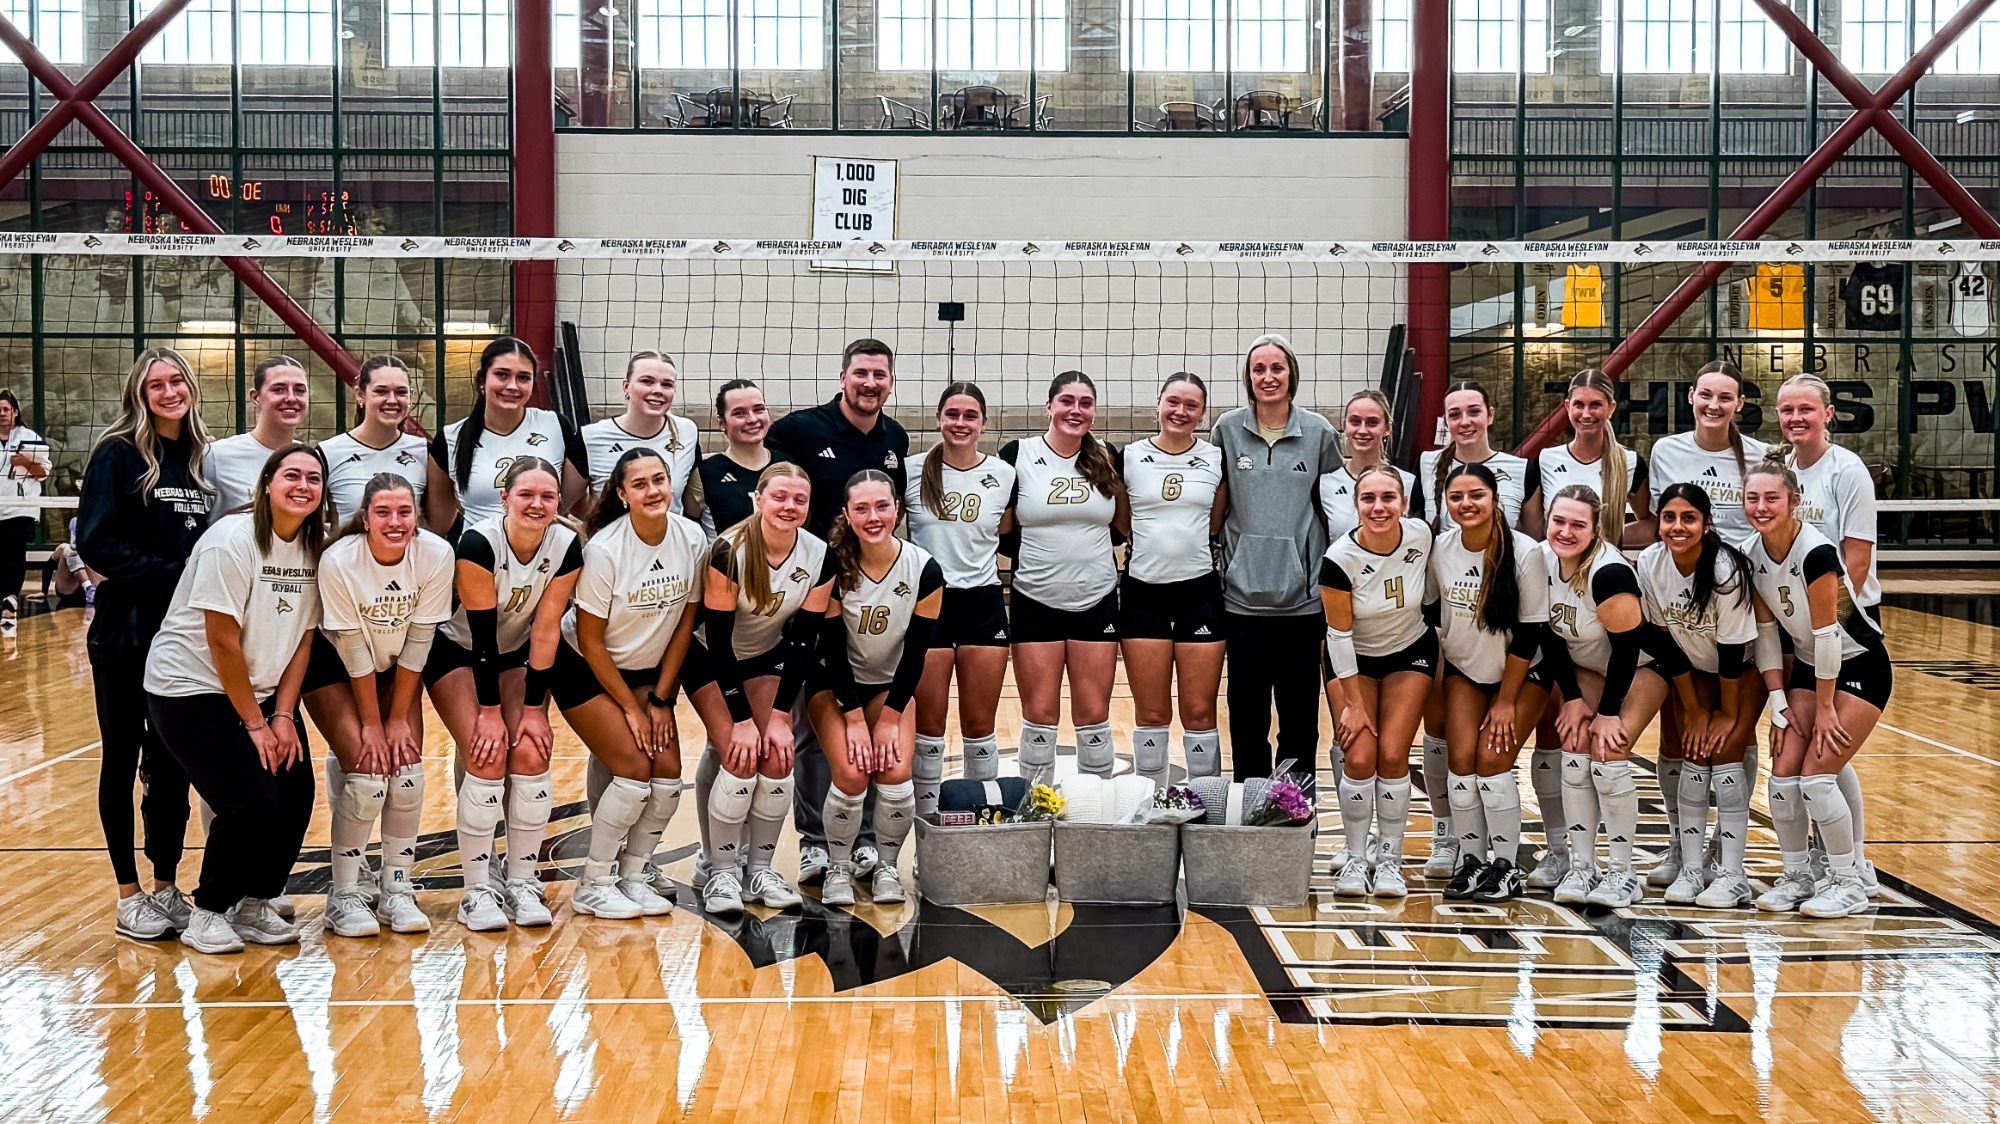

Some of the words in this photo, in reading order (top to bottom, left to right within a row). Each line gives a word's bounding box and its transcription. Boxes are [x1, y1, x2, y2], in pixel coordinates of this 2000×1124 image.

[842, 188, 867, 206] DIG
[835, 212, 872, 231] CLUB
[14, 233, 57, 243] WESLEYAN
[127, 235, 172, 245] NEBRASKA
[173, 236, 216, 246] WESLEYAN
[286, 236, 331, 247] NEBRASKA
[331, 237, 374, 247] WESLEYAN
[444, 237, 488, 247] NEBRASKA
[489, 238, 531, 248] WESLEYAN
[600, 239, 644, 249] NEBRASKA
[644, 239, 687, 249] WESLEYAN
[756, 240, 800, 250] NEBRASKA
[800, 240, 842, 250] WESLEYAN
[911, 241, 955, 250] NEBRASKA
[955, 241, 997, 251] WESLEYAN
[1065, 242, 1109, 251] NEBRASKA
[1109, 242, 1151, 251] WESLEYAN
[1676, 241, 1719, 251] NEBRASKA
[1719, 241, 1761, 251] WESLEYAN
[1828, 241, 1871, 250] NEBRASKA
[1871, 241, 1912, 250] WESLEYAN
[1218, 242, 1262, 252] NEBRASKA
[1262, 242, 1304, 252] WESLEYAN
[1371, 242, 1415, 252] NEBRASKA
[1415, 242, 1457, 252] WESLEYAN
[1524, 242, 1567, 252] NEBRASKA
[1567, 242, 1609, 252] WESLEYAN
[1769, 277, 1783, 298] 5
[1960, 275, 1986, 297] 42
[1860, 284, 1894, 316] 69
[1047, 477, 1091, 504] 25
[1161, 473, 1183, 501] 6
[1709, 486, 1744, 503] EYAN
[940, 491, 982, 522] 28
[627, 577, 689, 604] WESLEYAN
[1384, 575, 1404, 609] 4
[1778, 586, 1795, 618] 5
[857, 605, 891, 635] 16
[1550, 602, 1580, 638] 24
